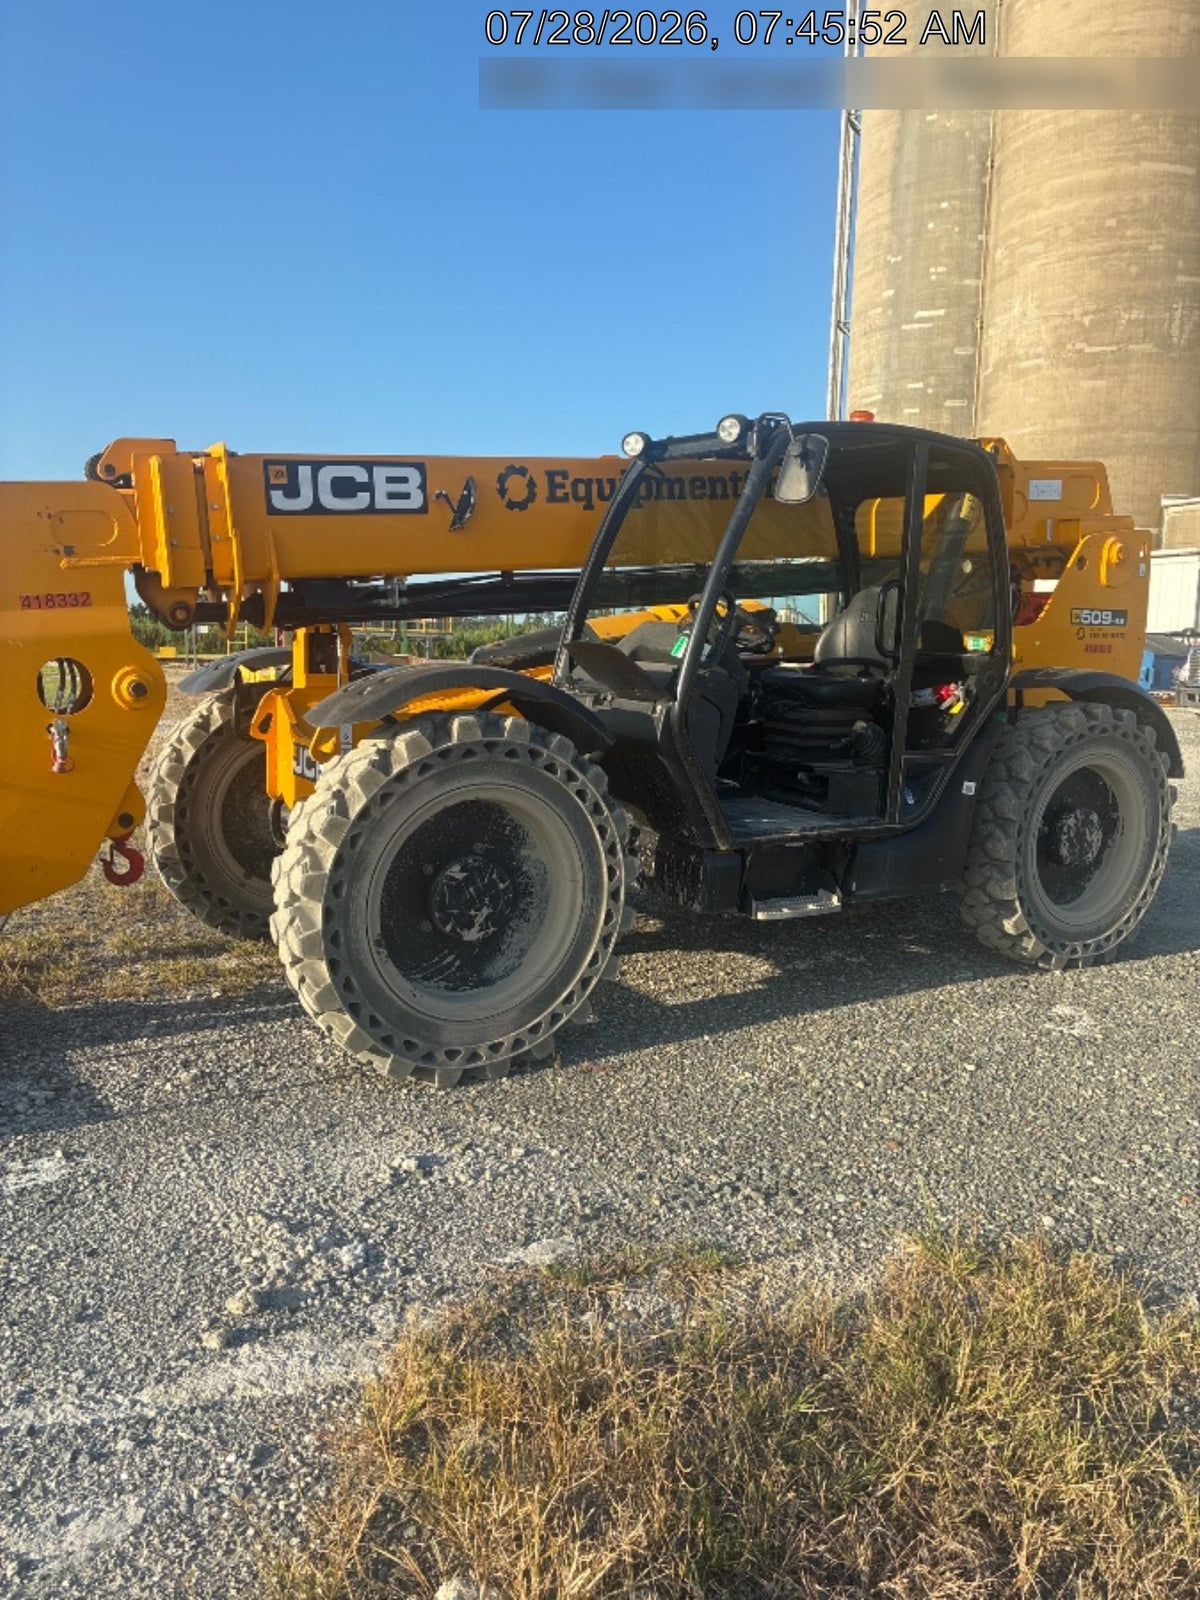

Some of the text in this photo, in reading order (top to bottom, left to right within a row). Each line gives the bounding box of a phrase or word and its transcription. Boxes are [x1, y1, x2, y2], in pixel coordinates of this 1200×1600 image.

[269, 465, 424, 511] JCB
[21, 592, 92, 609] 418332
[294, 746, 320, 780] JC
